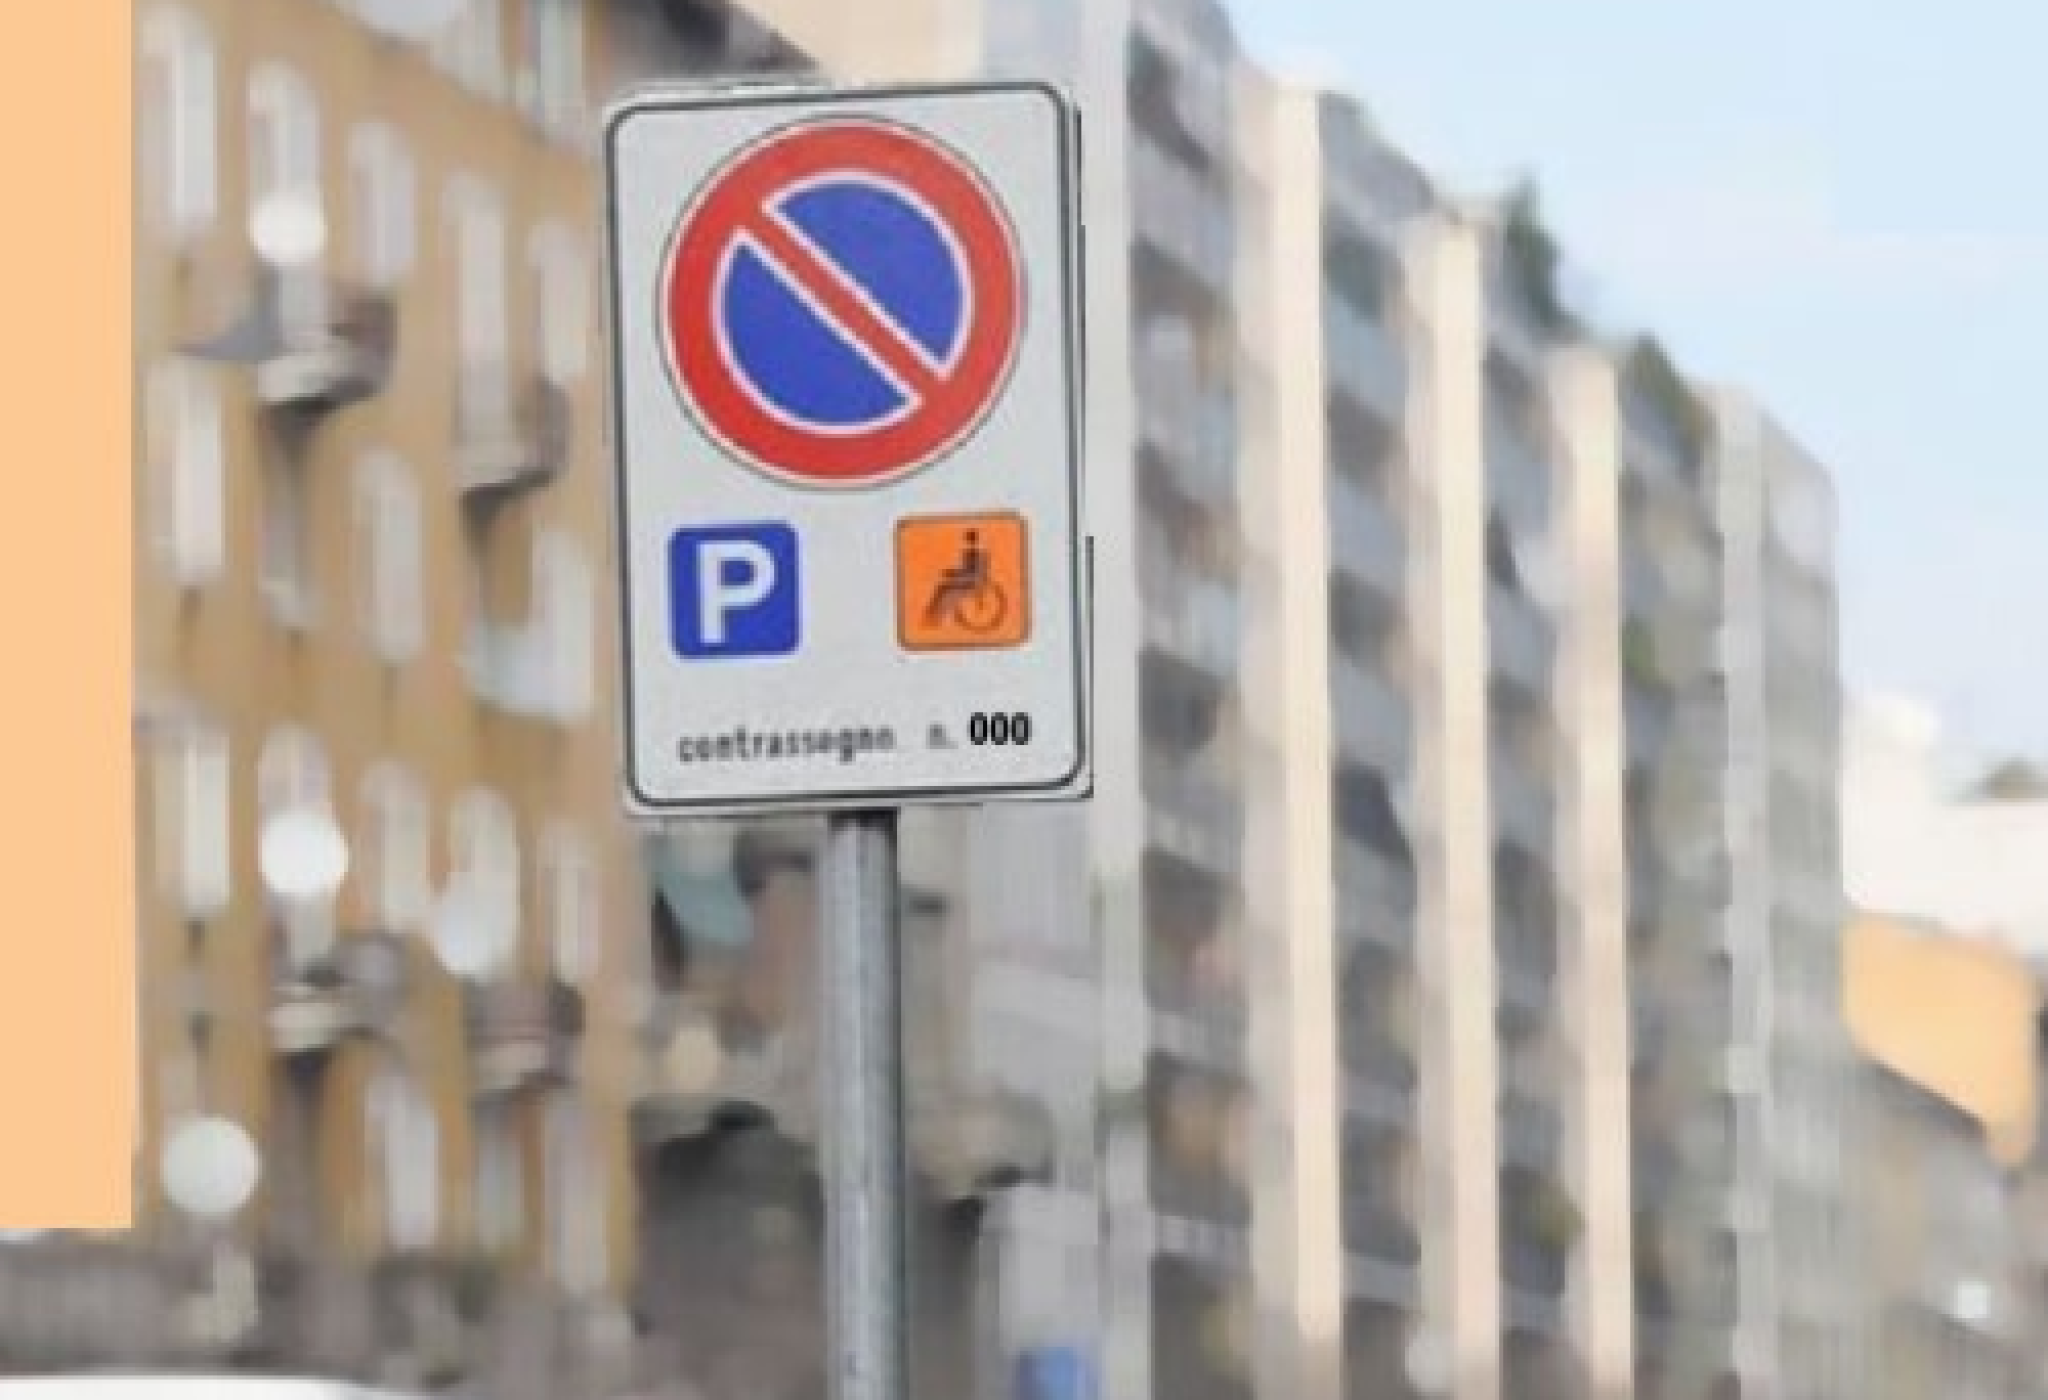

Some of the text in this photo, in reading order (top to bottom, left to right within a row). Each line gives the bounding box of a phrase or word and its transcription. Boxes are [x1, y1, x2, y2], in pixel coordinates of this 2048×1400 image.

[696, 539, 775, 645] P
[677, 725, 896, 765] contrassegno
[968, 711, 1032, 746] 000
